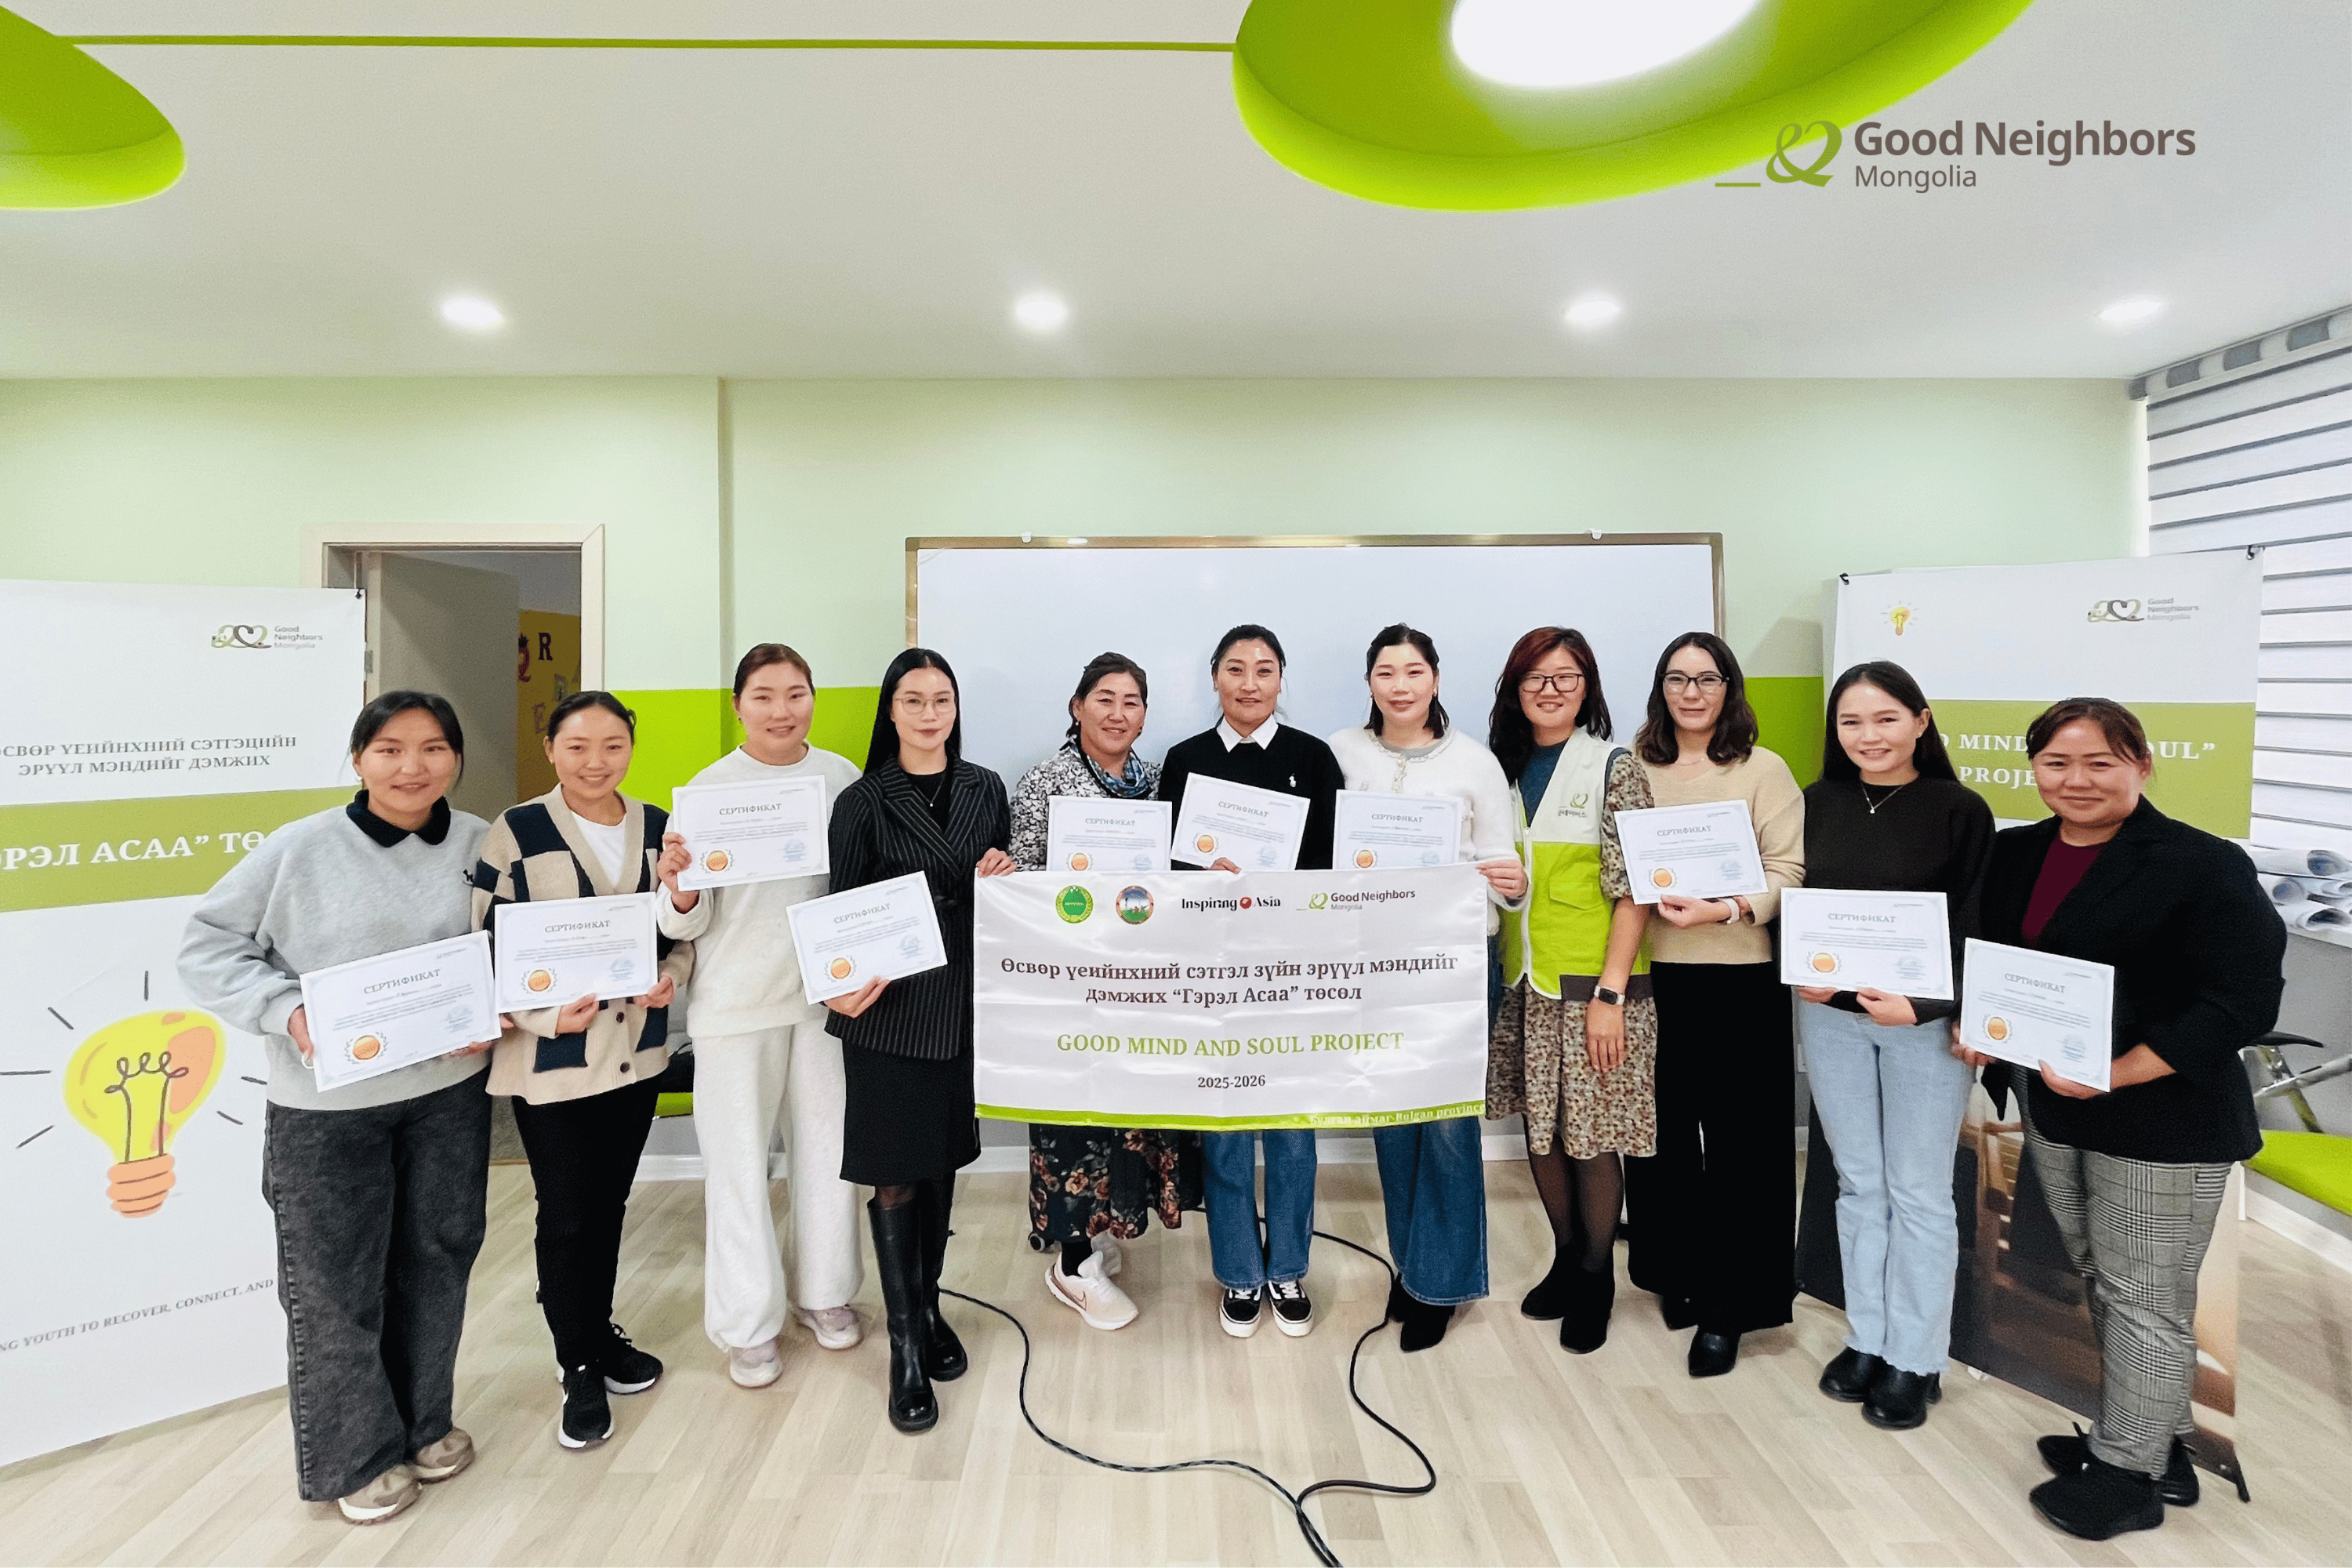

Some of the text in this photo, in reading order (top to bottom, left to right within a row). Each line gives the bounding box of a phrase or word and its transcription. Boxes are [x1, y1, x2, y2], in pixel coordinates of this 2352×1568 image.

[0, 735, 297, 757] СВӨР ҮЕИЙНХНИЙ СЭТГЭЦИЙН
[2147, 740, 2216, 760] UL”
[19, 754, 270, 776] ЭРҮҮЛ МЭНДИЙГ ДЭМЖИХ
[1959, 766, 2038, 789] PROJE
[719, 803, 782, 815] СЕРТИФИКАТ
[1218, 801, 1269, 818] СЕРТИФИКАТ
[1371, 813, 1424, 823] СЕРТИФИКАТ
[1085, 817, 1136, 827] СЕРТИФИКАТ
[0, 844, 81, 870] РЭЛ
[90, 835, 210, 864] АСАА”
[1181, 896, 1238, 913] Inspiring
[1330, 889, 1416, 902] Good Neighbors
[834, 902, 891, 924] СЕРТИФИКАТ
[1828, 913, 1896, 923] СЕРТИФИКАТ
[544, 920, 611, 934] СЕРТИФИКАТ
[1001, 953, 1458, 981] Өсвөр үеийнхний сэтгэл зүйн эрүүл мэндийг
[364, 968, 441, 995] СЕРТИФИКАТ
[2004, 972, 2066, 994] СЕРТИФИКАТ
[1086, 985, 1363, 1008] дэмжих “Гэрэл Асаа” төсөл
[1057, 1032, 1404, 1058] GOOD MIND AND SOUL PROJECT
[1197, 1074, 1266, 1089] 2025-2026
[1436, 1103, 1486, 1118] province
[24, 1326, 76, 1348] YOUTH
[80, 1320, 99, 1334] TO
[245, 1279, 274, 1294] AND
